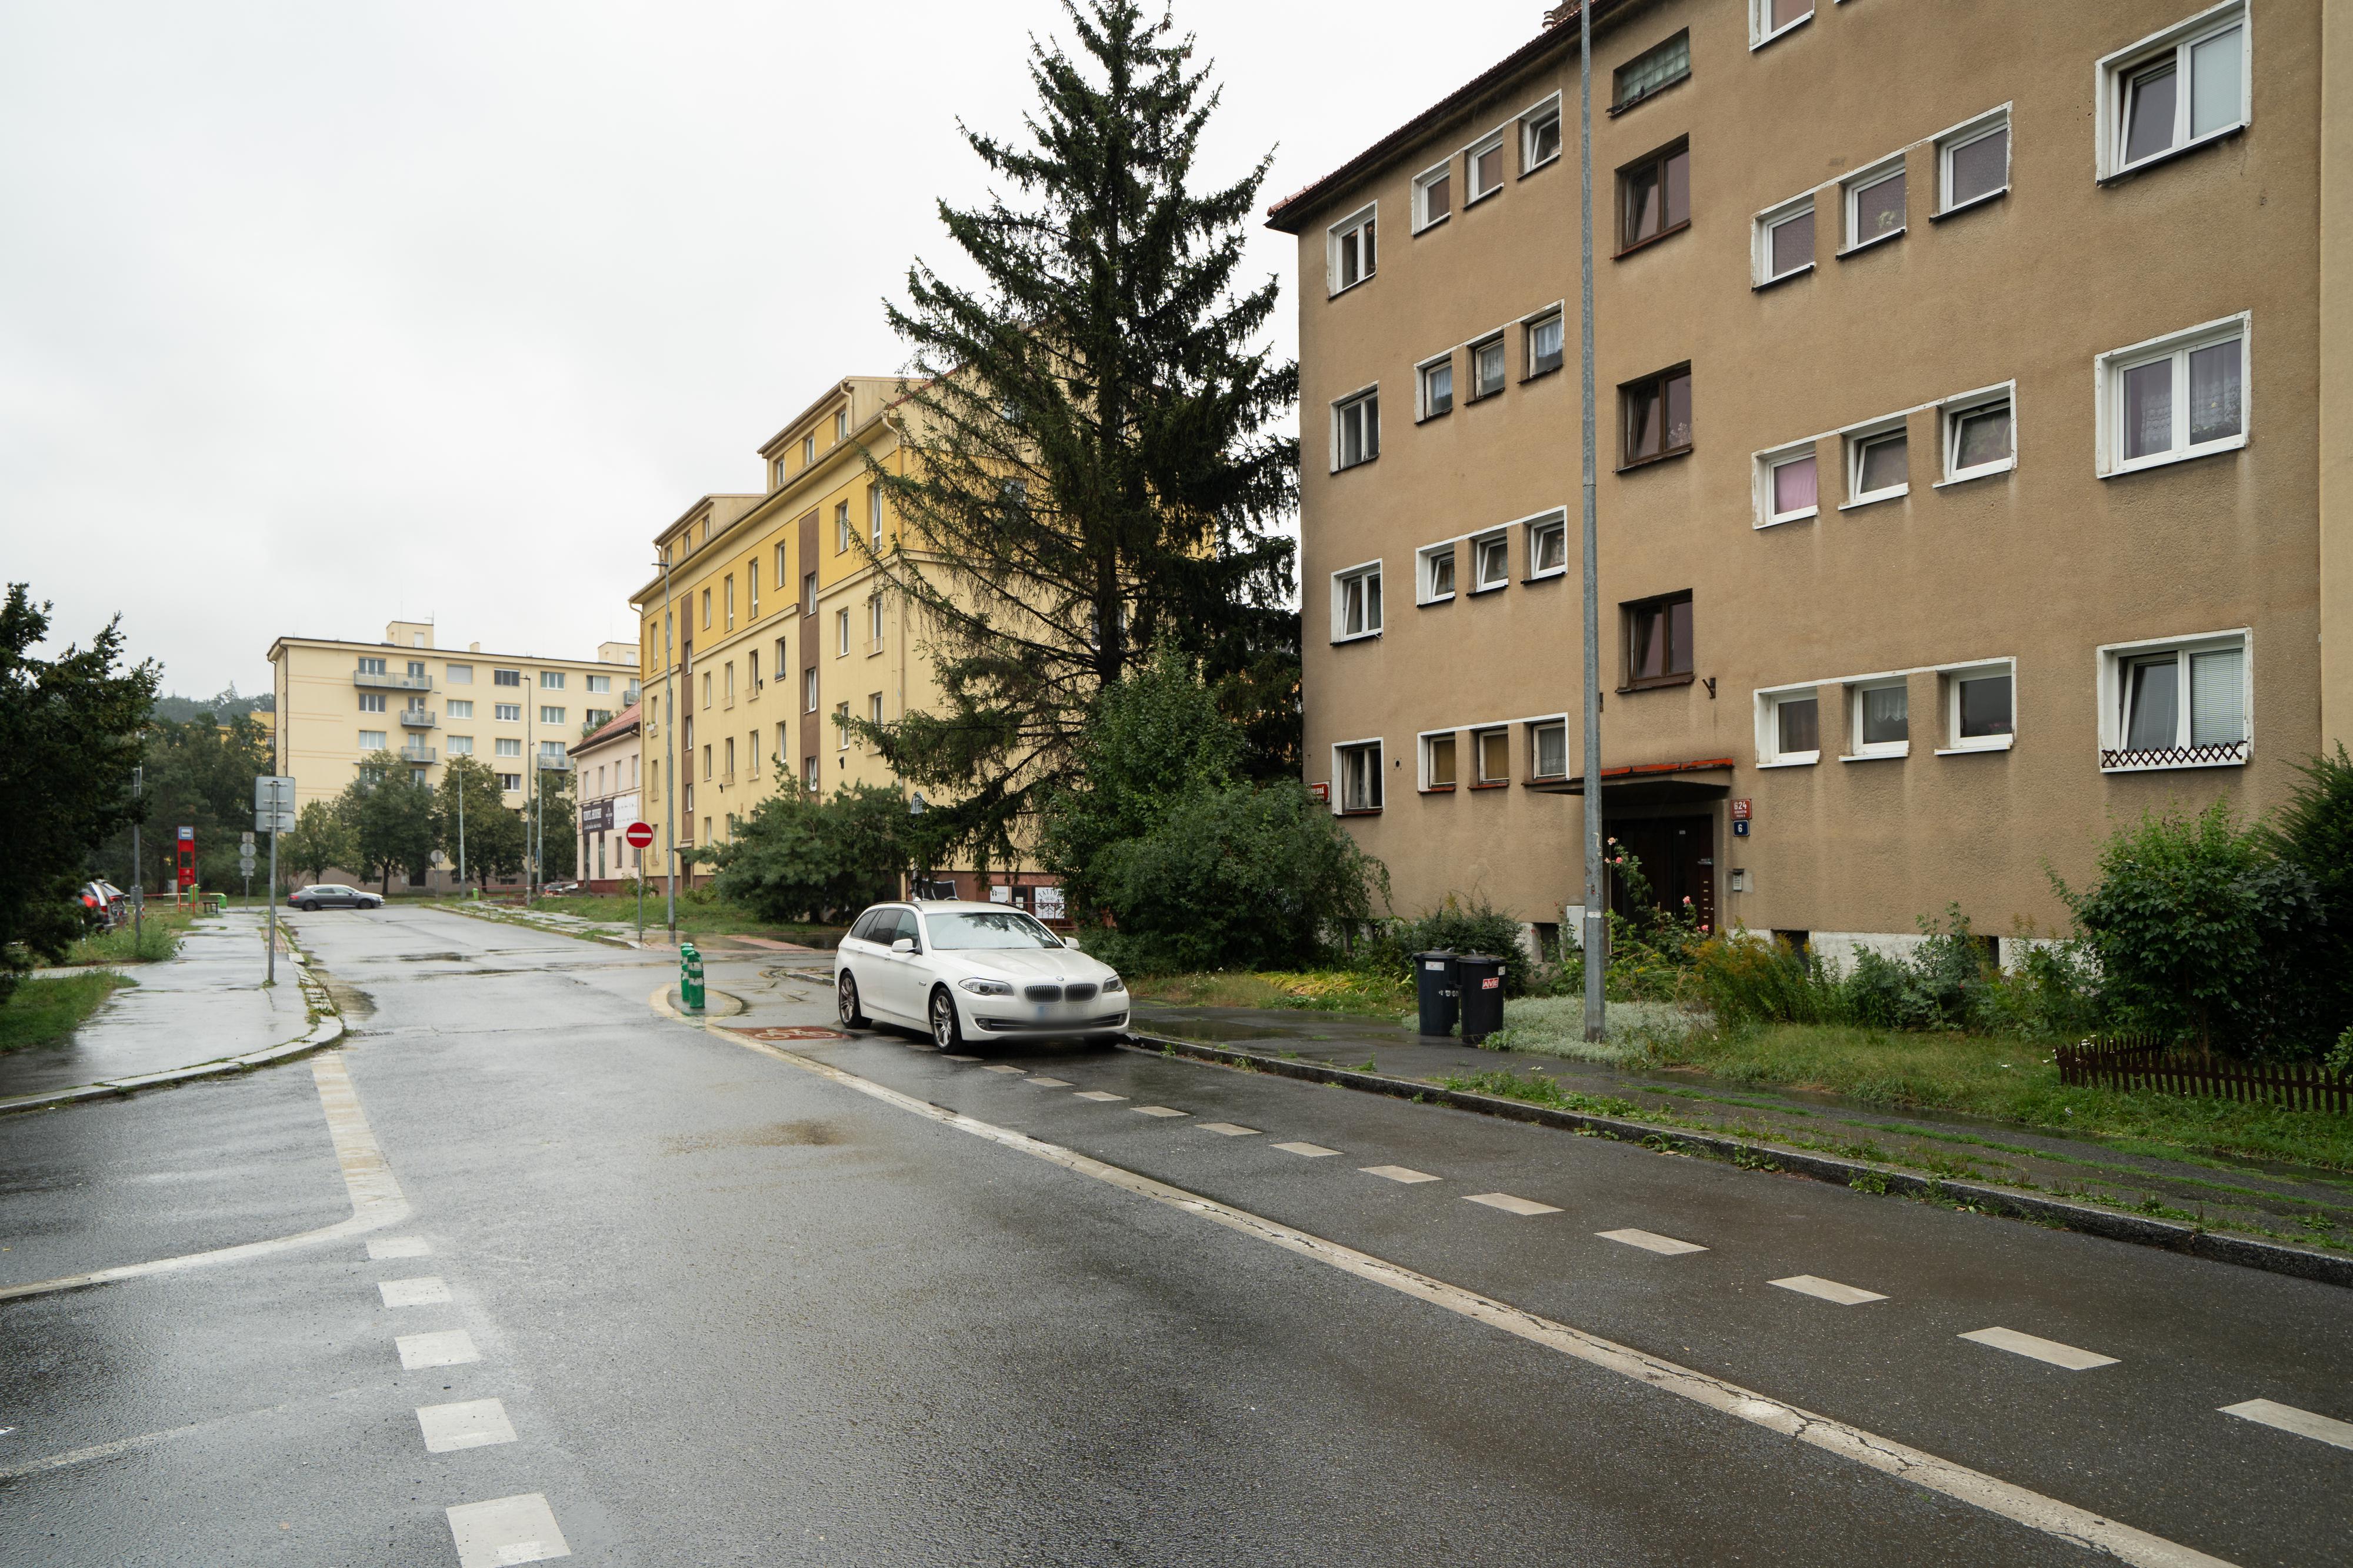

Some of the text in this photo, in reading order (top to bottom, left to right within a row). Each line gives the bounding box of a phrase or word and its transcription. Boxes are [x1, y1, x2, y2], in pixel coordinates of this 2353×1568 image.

[1734, 801, 1747, 810] 624
[1738, 823, 1743, 833] 6
[1484, 980, 1498, 988] AVE
